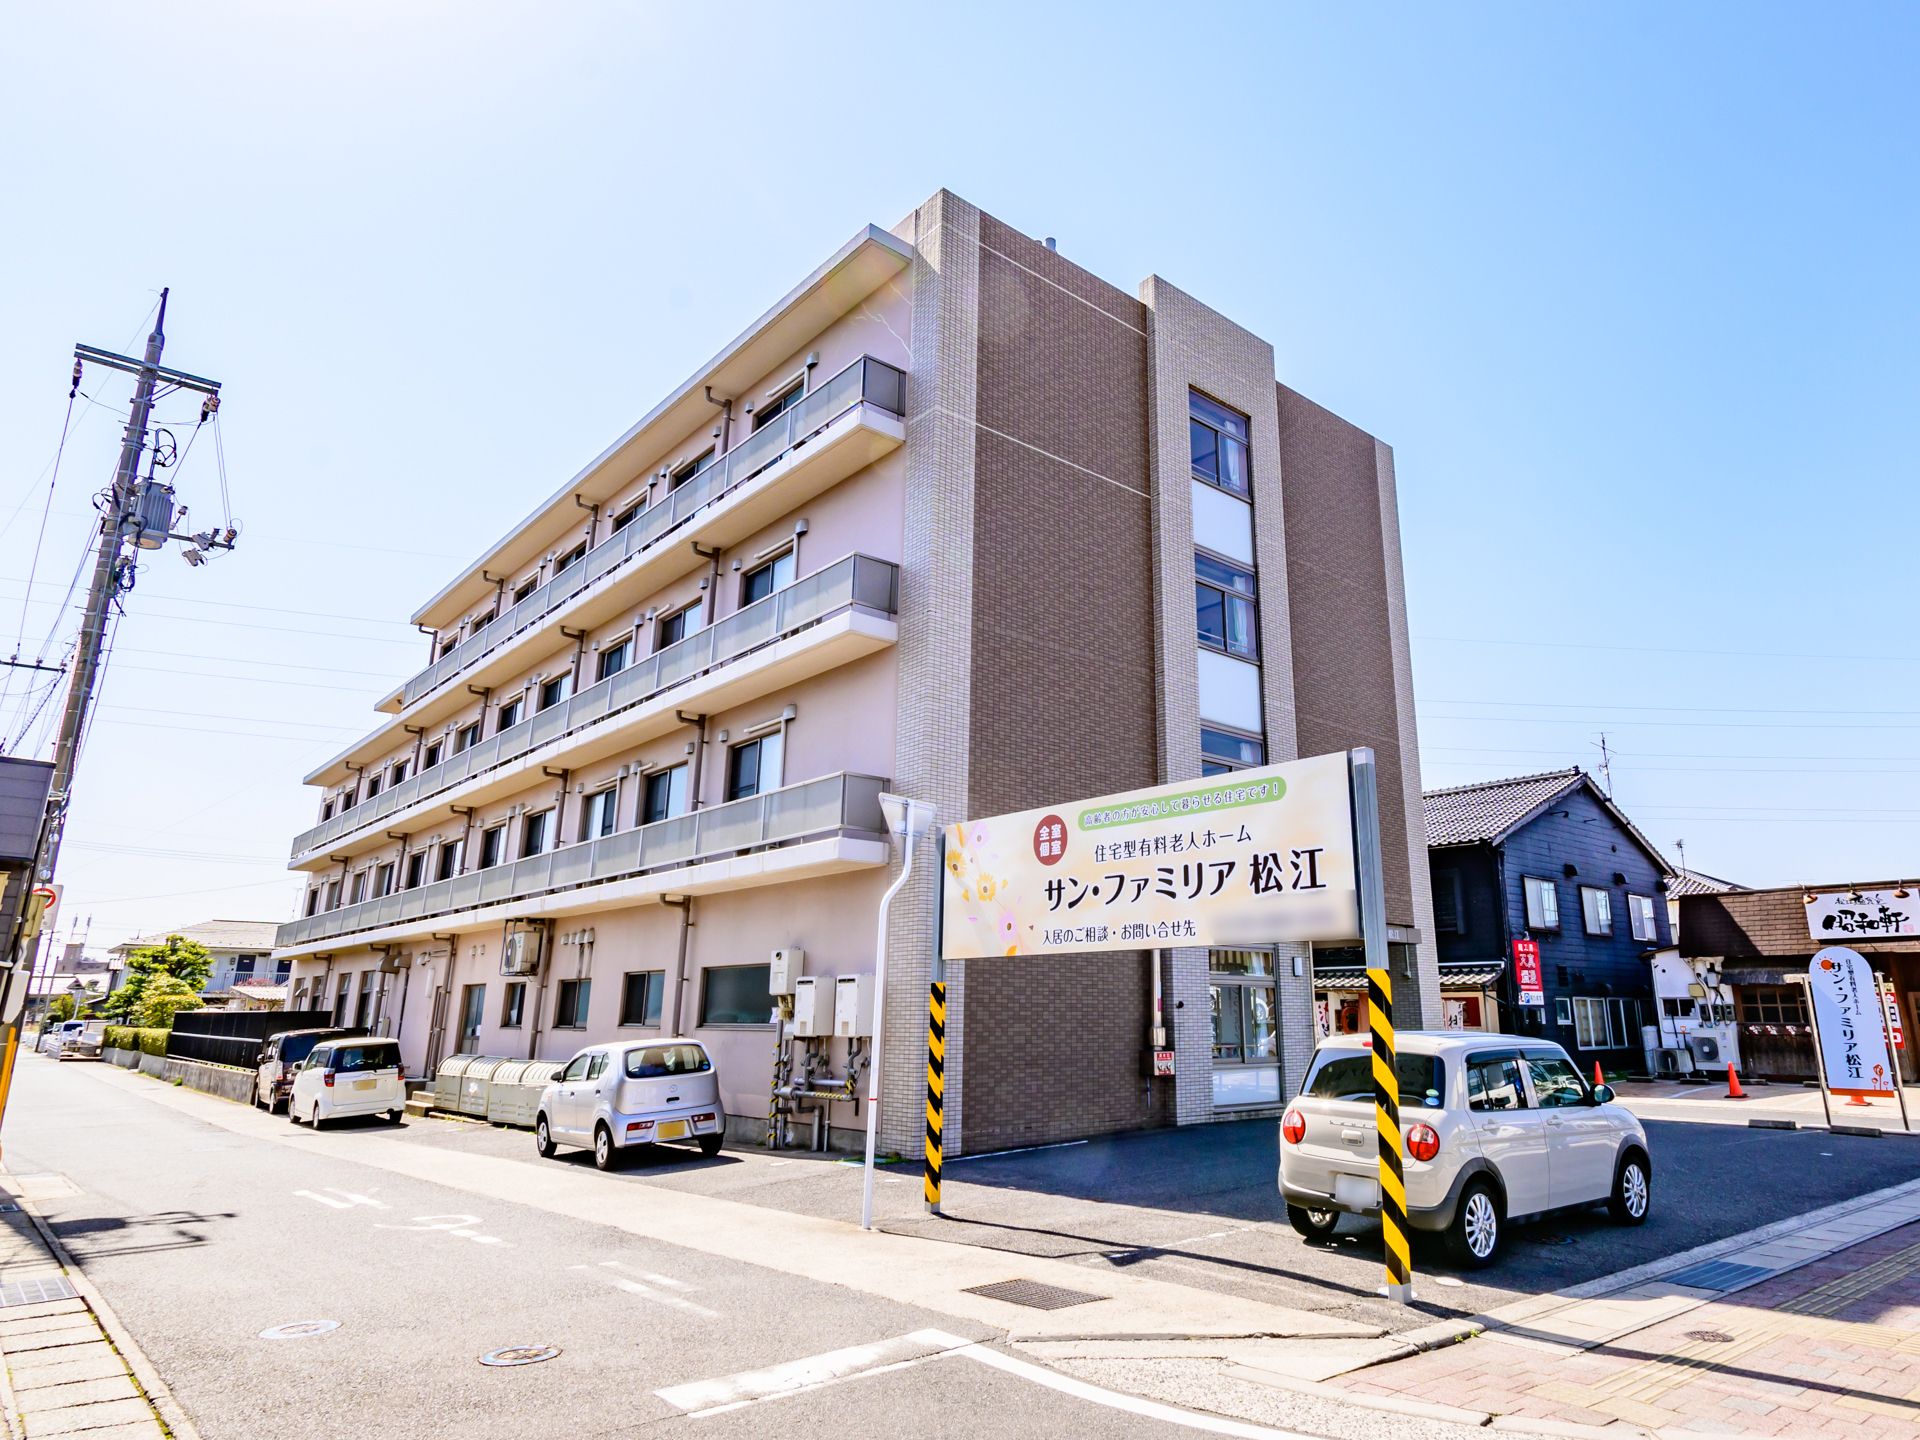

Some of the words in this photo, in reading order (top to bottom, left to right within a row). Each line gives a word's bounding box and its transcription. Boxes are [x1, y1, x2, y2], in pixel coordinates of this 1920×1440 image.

[1084, 783, 1279, 826] 高齢者の方が安心して暮らせる住宅です！
[1039, 824, 1062, 841] 全室
[1094, 824, 1252, 863] 住宅型有料老人ホーム
[1039, 841, 1062, 857] 個室
[1045, 861, 1236, 912] サン・ファミリア
[1249, 848, 1327, 895] 松江
[1042, 920, 1197, 945] 入居のご相談・お問い合せ先
[1822, 906, 1910, 934] 昭和軒
